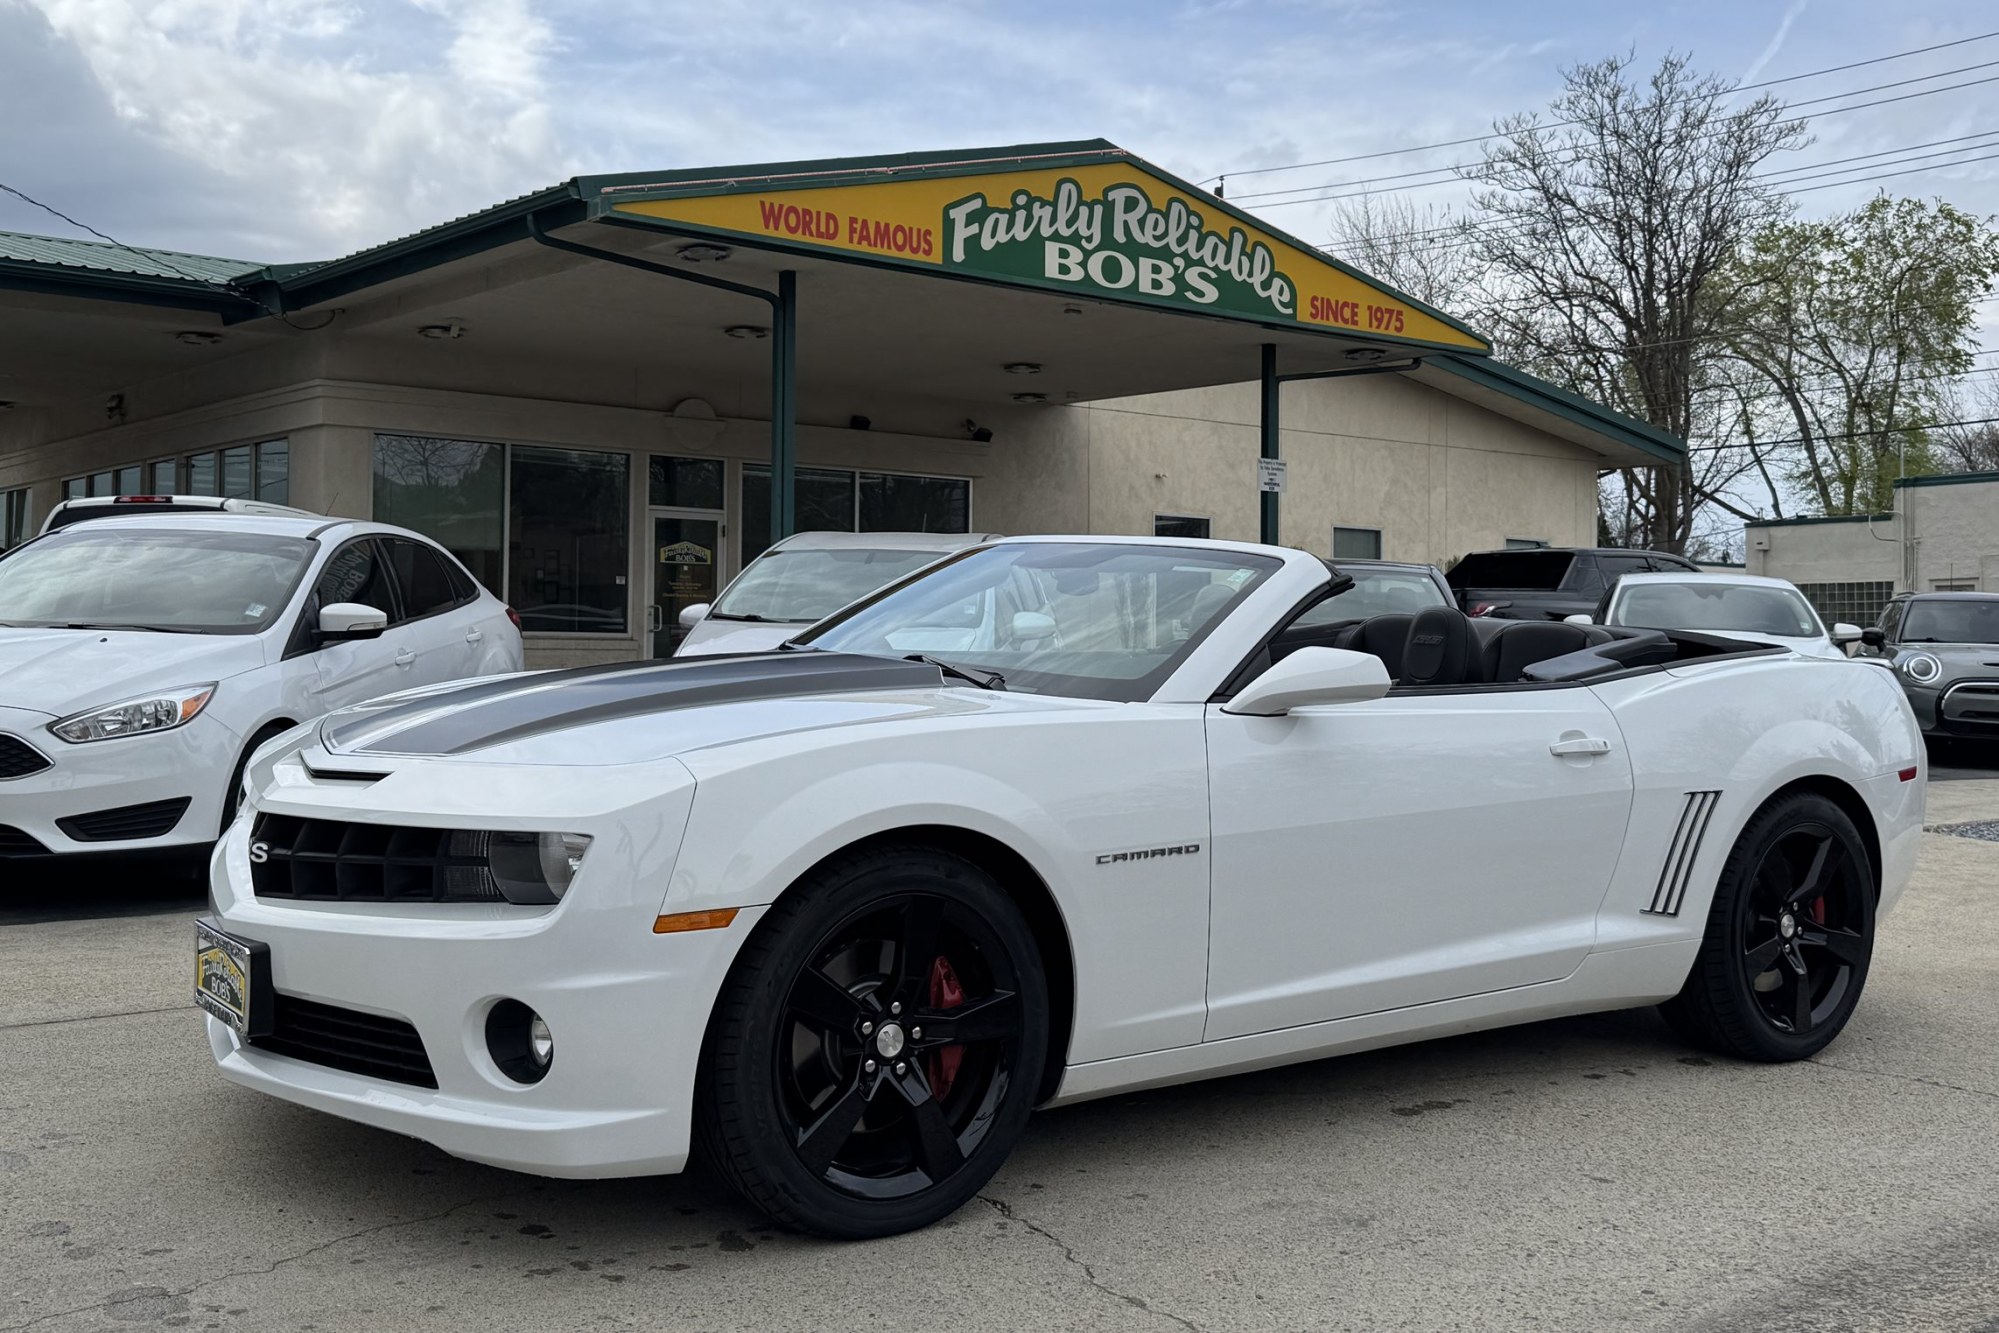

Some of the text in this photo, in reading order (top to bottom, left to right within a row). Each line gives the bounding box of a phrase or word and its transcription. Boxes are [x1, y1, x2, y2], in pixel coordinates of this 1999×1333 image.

[760, 200, 933, 256] WORLD FAMOUS
[949, 182, 1293, 314] Fairly Reliable
[1044, 240, 1219, 304] BOB'S
[1310, 295, 1405, 333] SINCE 1975
[1095, 844, 1200, 865] CAMARO
